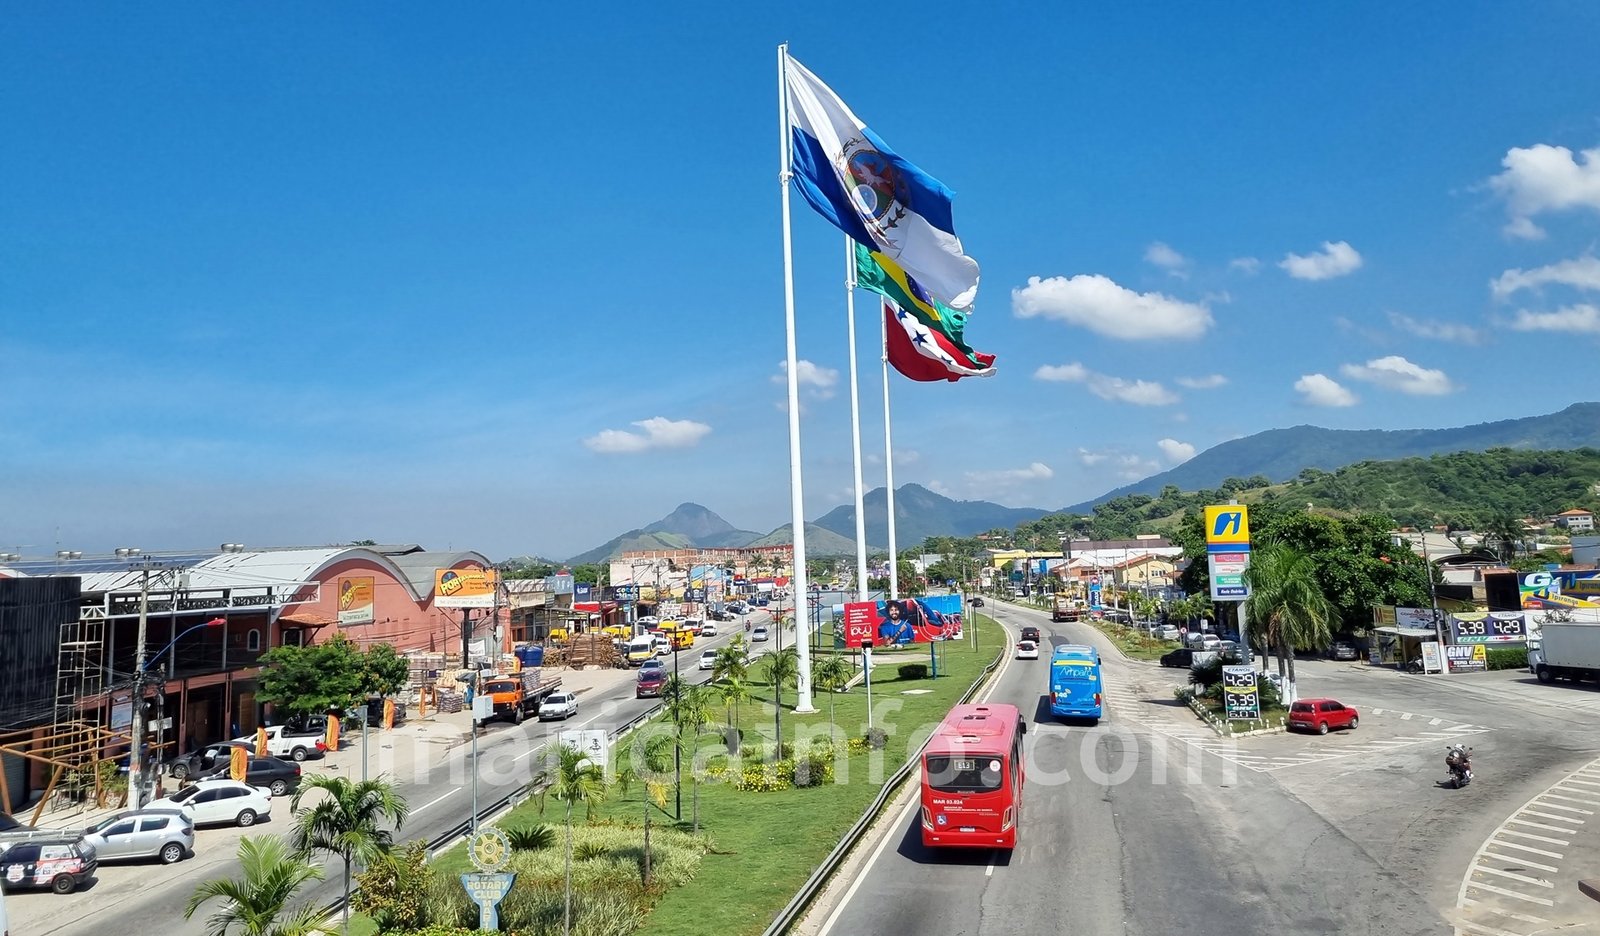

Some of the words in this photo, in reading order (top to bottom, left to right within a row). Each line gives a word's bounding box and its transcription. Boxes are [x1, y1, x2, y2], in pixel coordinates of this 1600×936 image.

[1447, 646, 1472, 658] GNV
[467, 881, 509, 891] ROTARY
[473, 890, 502, 899] CLUB
